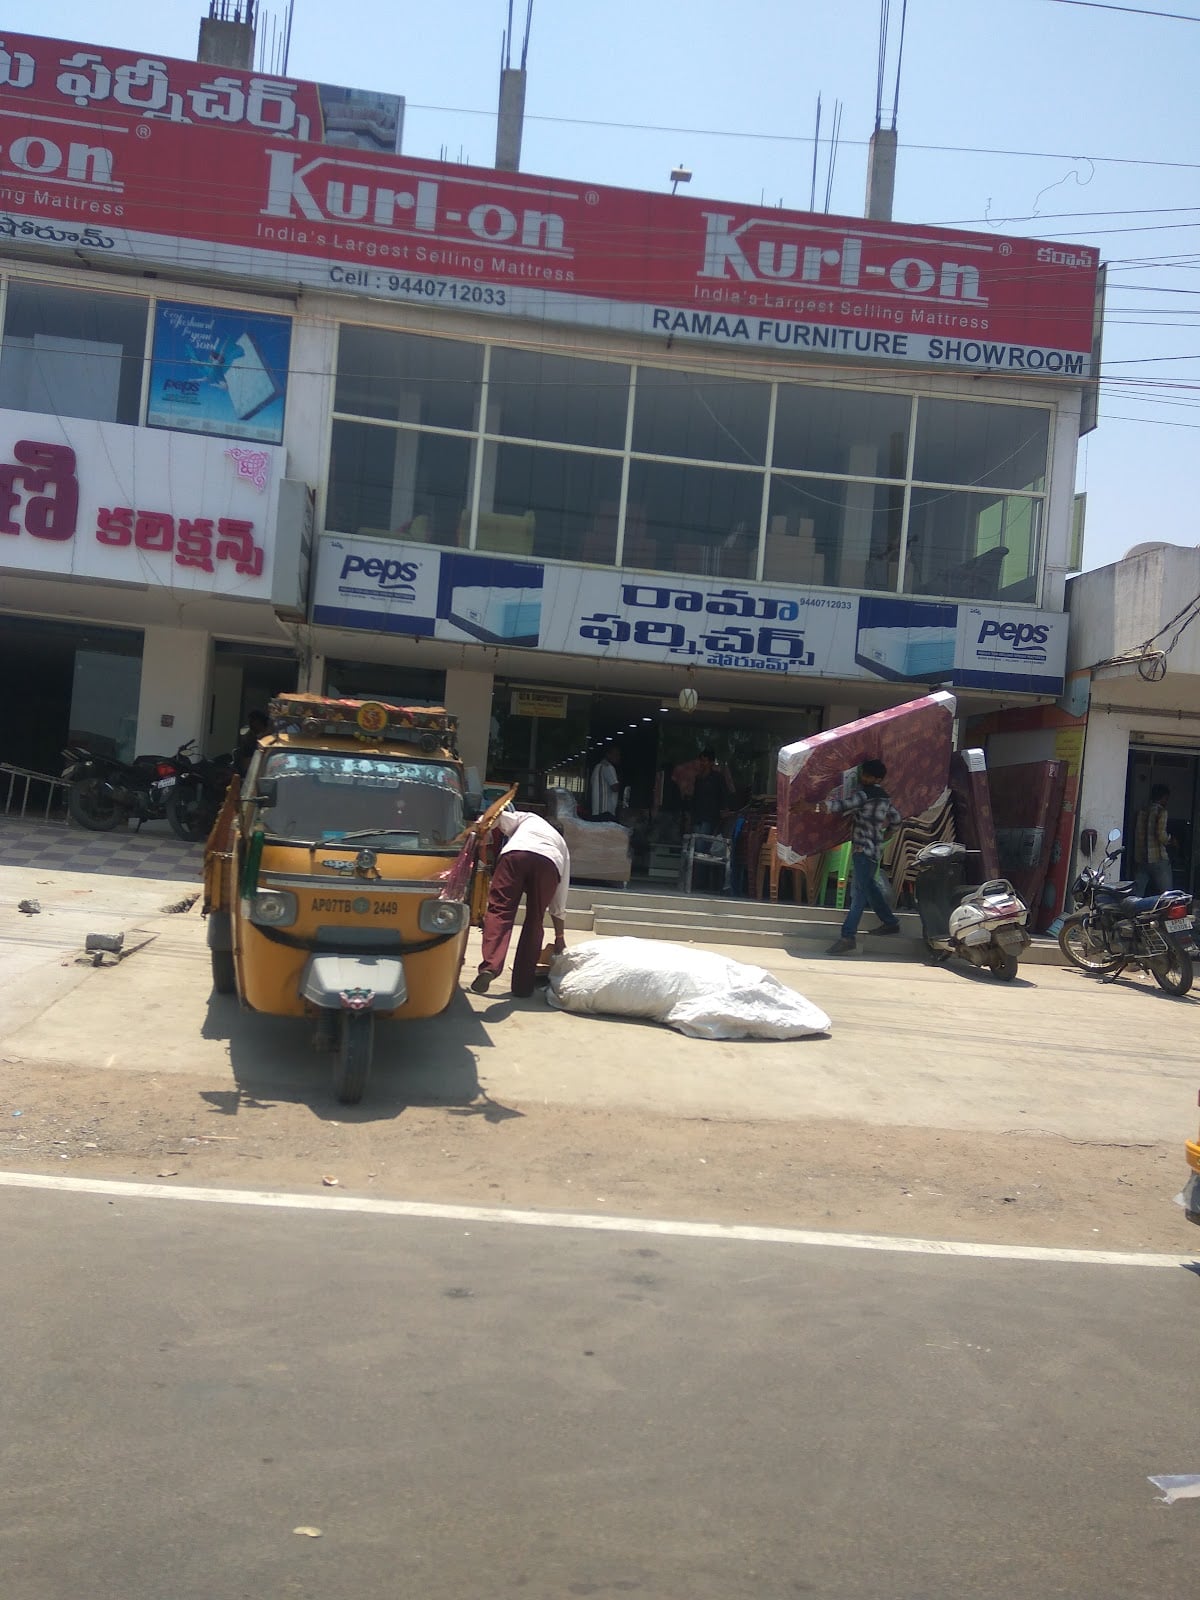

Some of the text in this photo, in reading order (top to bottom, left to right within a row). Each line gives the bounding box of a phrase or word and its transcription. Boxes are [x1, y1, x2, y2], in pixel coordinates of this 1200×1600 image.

[34, 190, 125, 216] Mattress
[260, 149, 574, 259] Kurl-on
[257, 223, 575, 282] India's Largest Selling Mattress
[697, 212, 989, 307] Kurl-on
[329, 265, 369, 288] Cell
[387, 275, 507, 306] 9440712033
[694, 284, 989, 330] India's Largest Selling Mattress
[652, 308, 1084, 375] RAMAA FURNITURE SHOWROOM
[339, 554, 419, 584] peps
[799, 597, 852, 610] 9440712033
[977, 620, 1050, 647] peps
[373, 901, 399, 915] 2449
